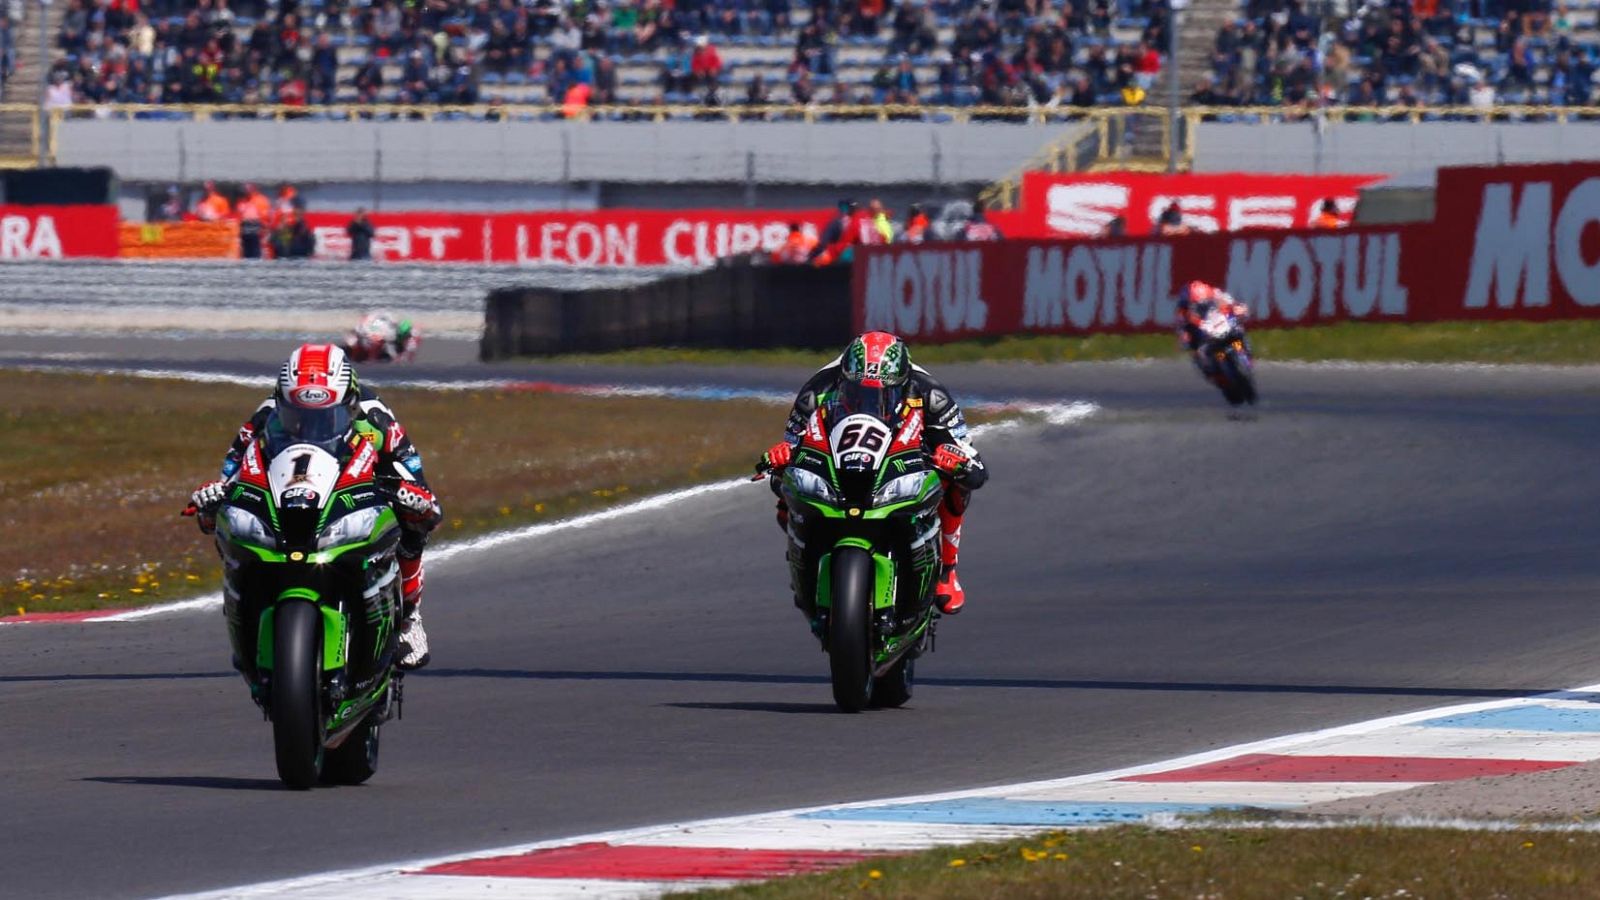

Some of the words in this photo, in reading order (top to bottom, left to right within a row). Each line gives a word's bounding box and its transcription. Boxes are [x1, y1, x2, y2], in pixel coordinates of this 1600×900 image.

[1, 215, 63, 259] RA
[516, 222, 639, 267] LEON
[865, 249, 988, 335] MOTUL
[1023, 244, 1179, 328] MOTUL
[1225, 233, 1408, 320] MOTUL
[836, 423, 886, 453] 66
[291, 453, 312, 477] 1
